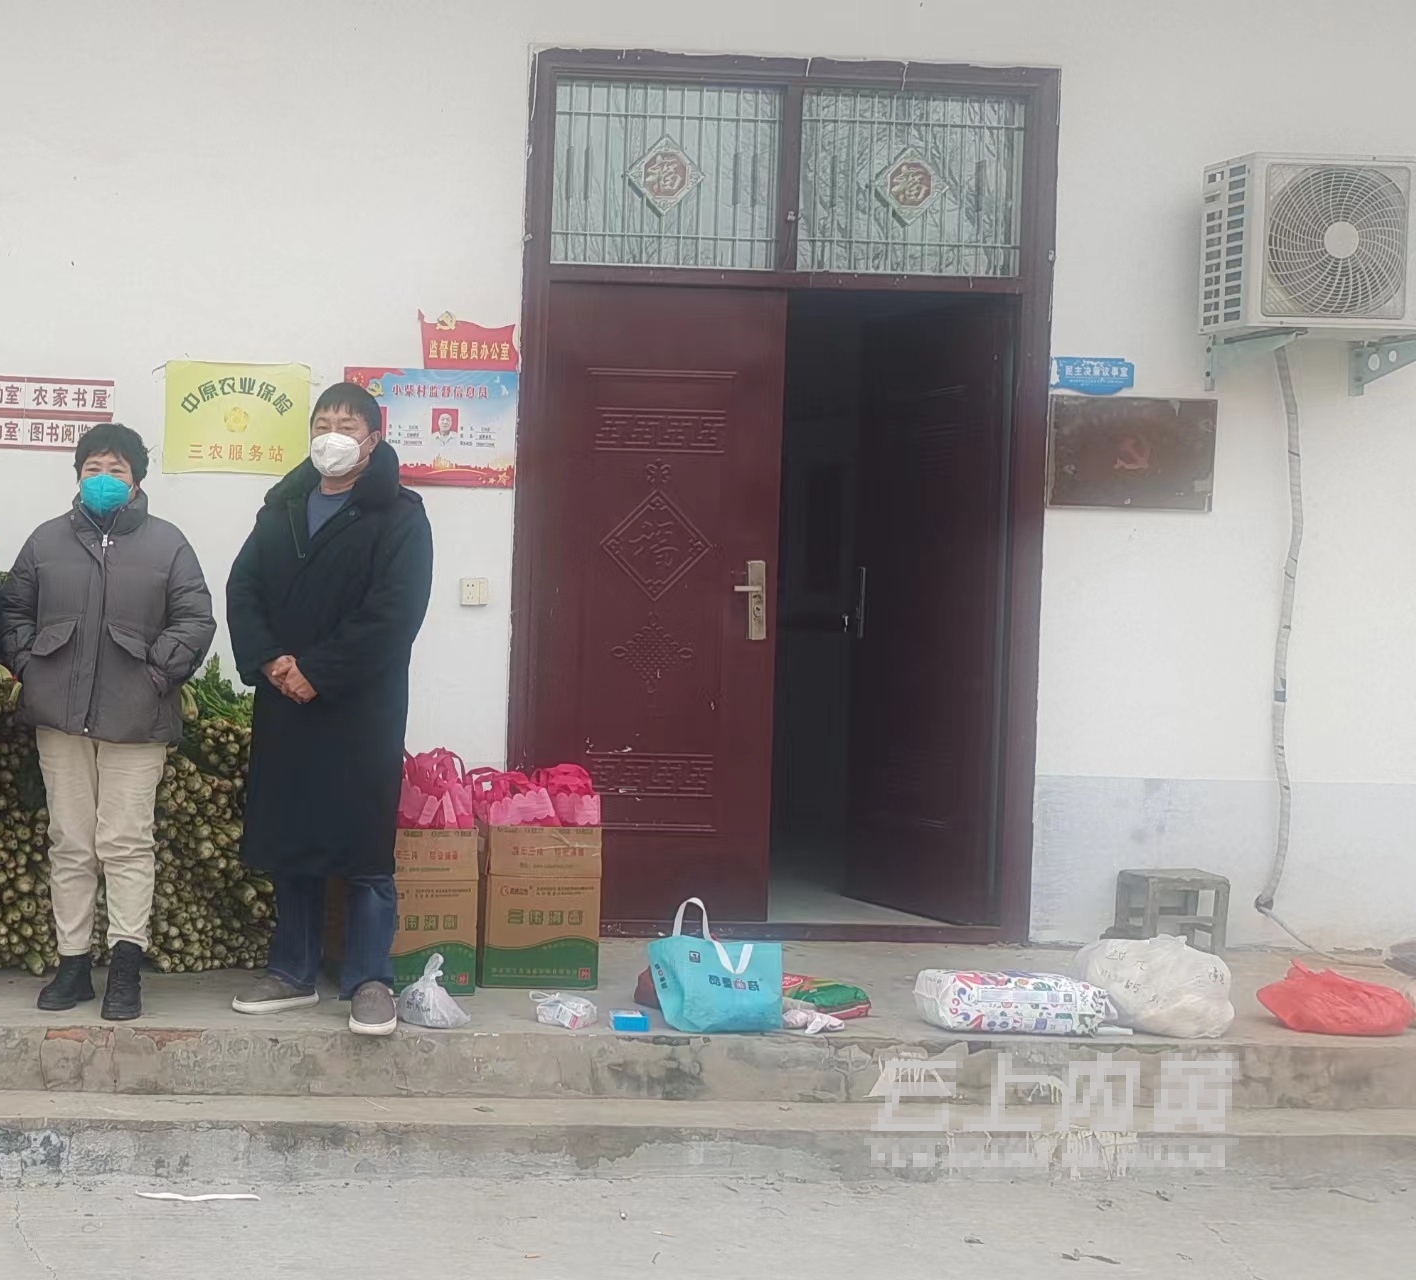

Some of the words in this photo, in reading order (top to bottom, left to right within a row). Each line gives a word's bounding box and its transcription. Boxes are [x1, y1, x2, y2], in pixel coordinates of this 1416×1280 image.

[429, 340, 510, 361] 监督信息员办公室
[32, 386, 108, 409] 农家书屋
[180, 376, 294, 417] 中原农业保险
[392, 383, 489, 400] 小柴村监督信息员
[188, 443, 284, 463] 三农服务站
